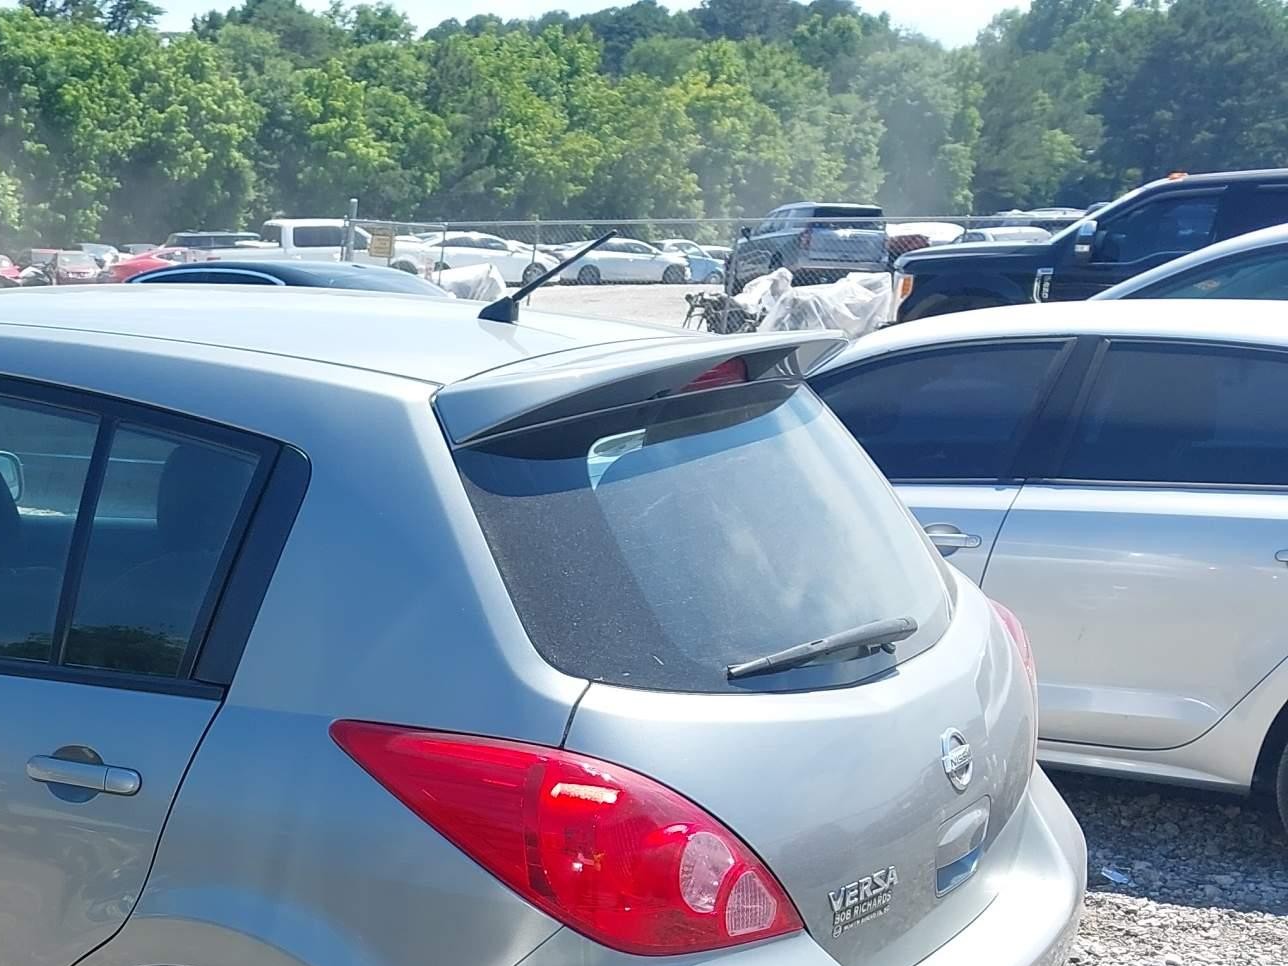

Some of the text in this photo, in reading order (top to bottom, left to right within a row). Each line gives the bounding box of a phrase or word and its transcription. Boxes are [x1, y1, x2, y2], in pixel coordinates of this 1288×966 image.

[828, 866, 898, 911] VERSA
[834, 908, 852, 924] BOB
[853, 890, 892, 918] RICHARDS
